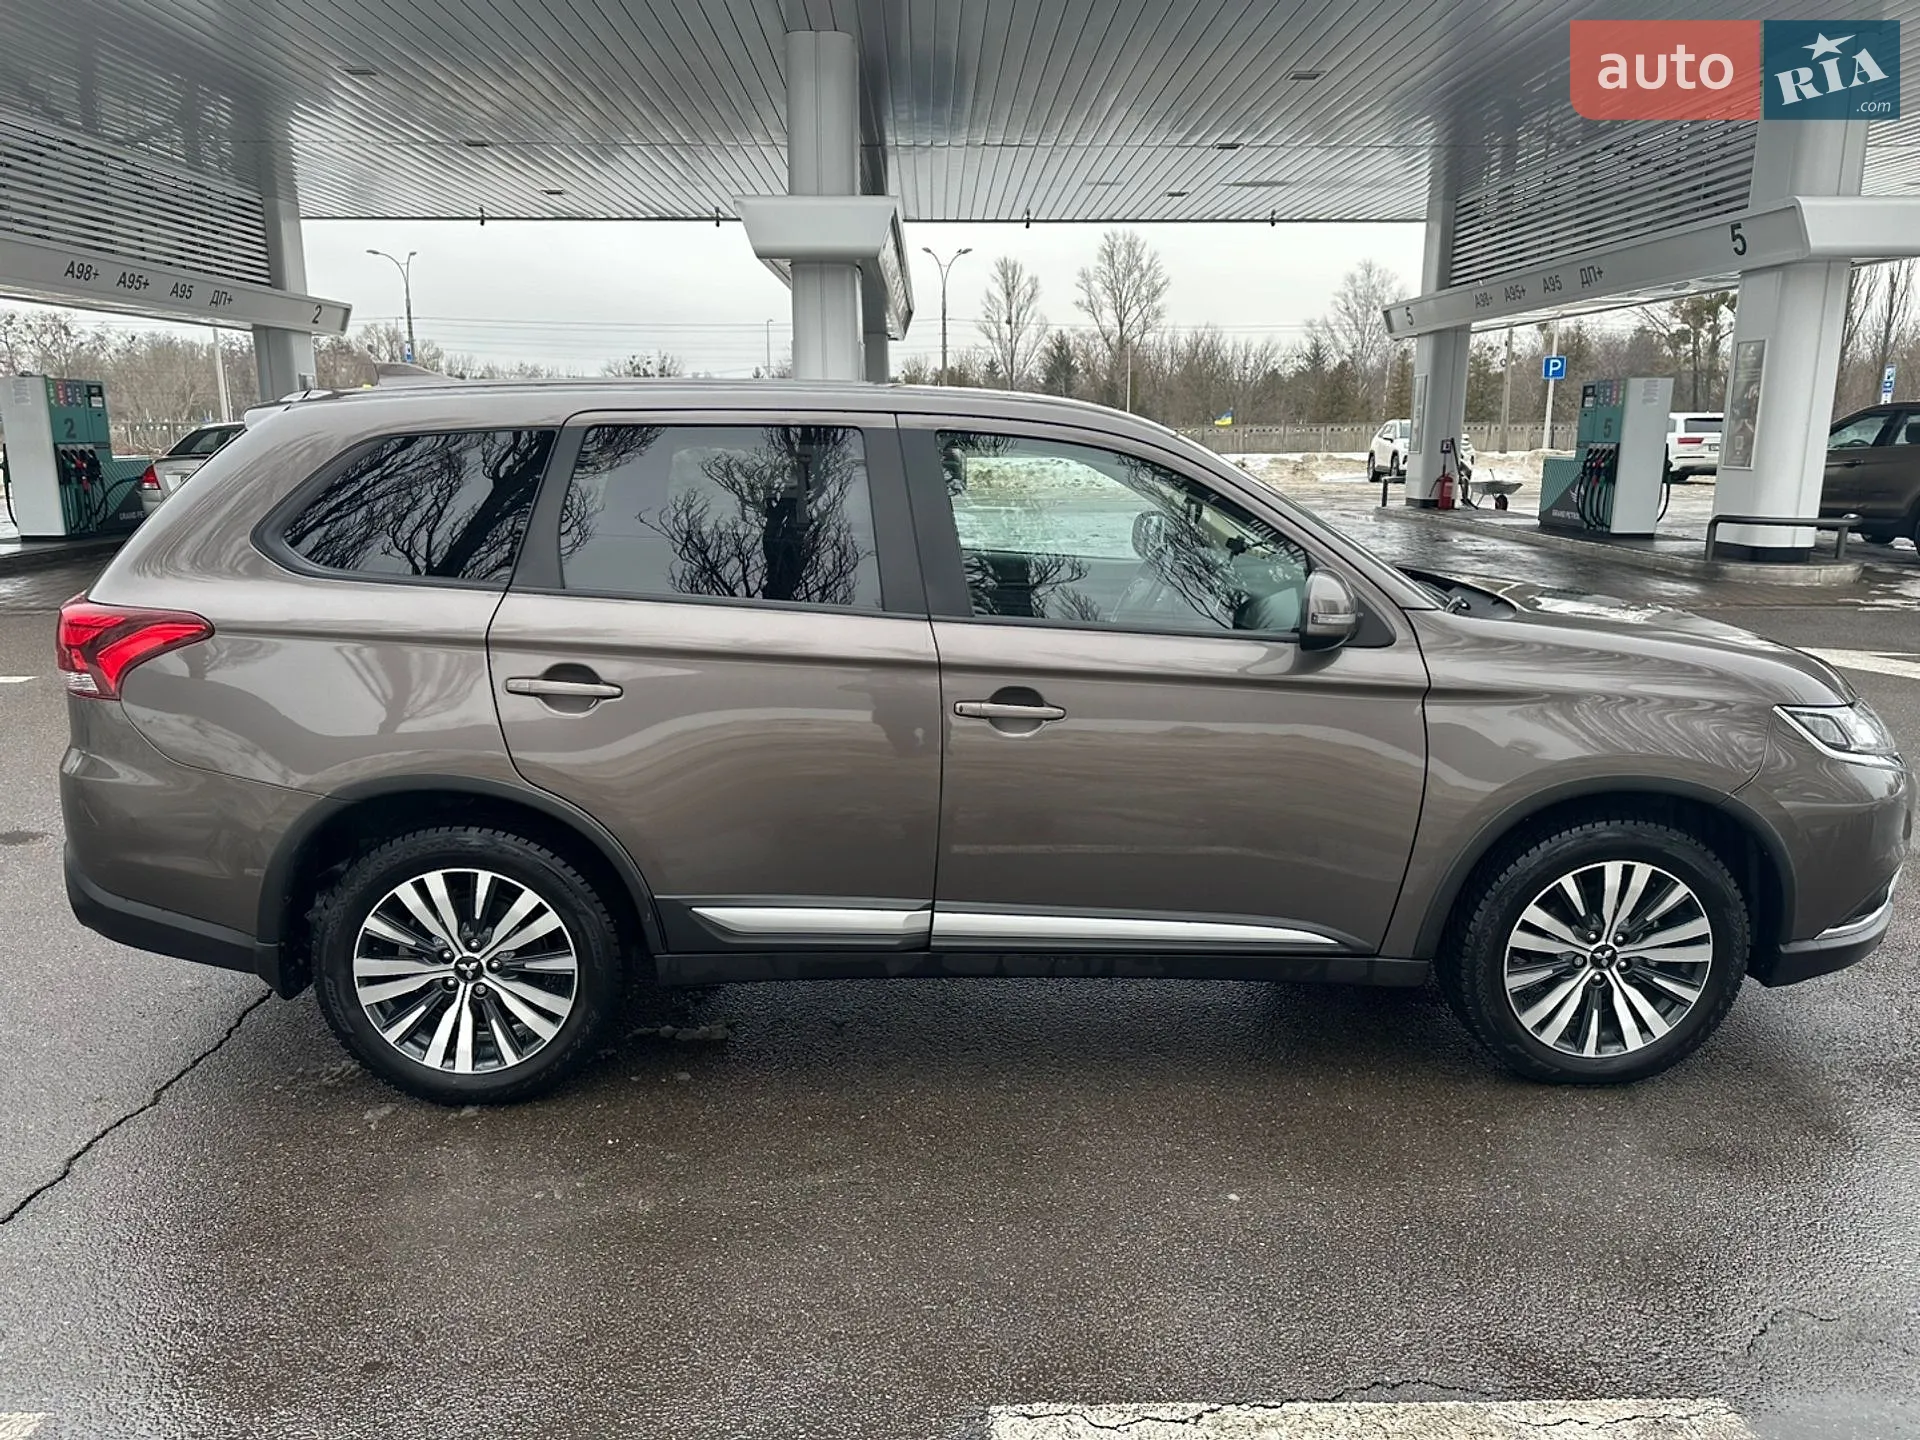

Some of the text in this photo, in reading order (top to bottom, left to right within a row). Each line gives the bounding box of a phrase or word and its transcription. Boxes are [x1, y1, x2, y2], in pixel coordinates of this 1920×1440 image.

[1405, 306, 1415, 326] 5
[1730, 223, 1747, 256] 5
[311, 304, 322, 324] 2
[1549, 359, 1561, 376] P
[64, 418, 77, 439] 2
[1603, 418, 1613, 438] 5
